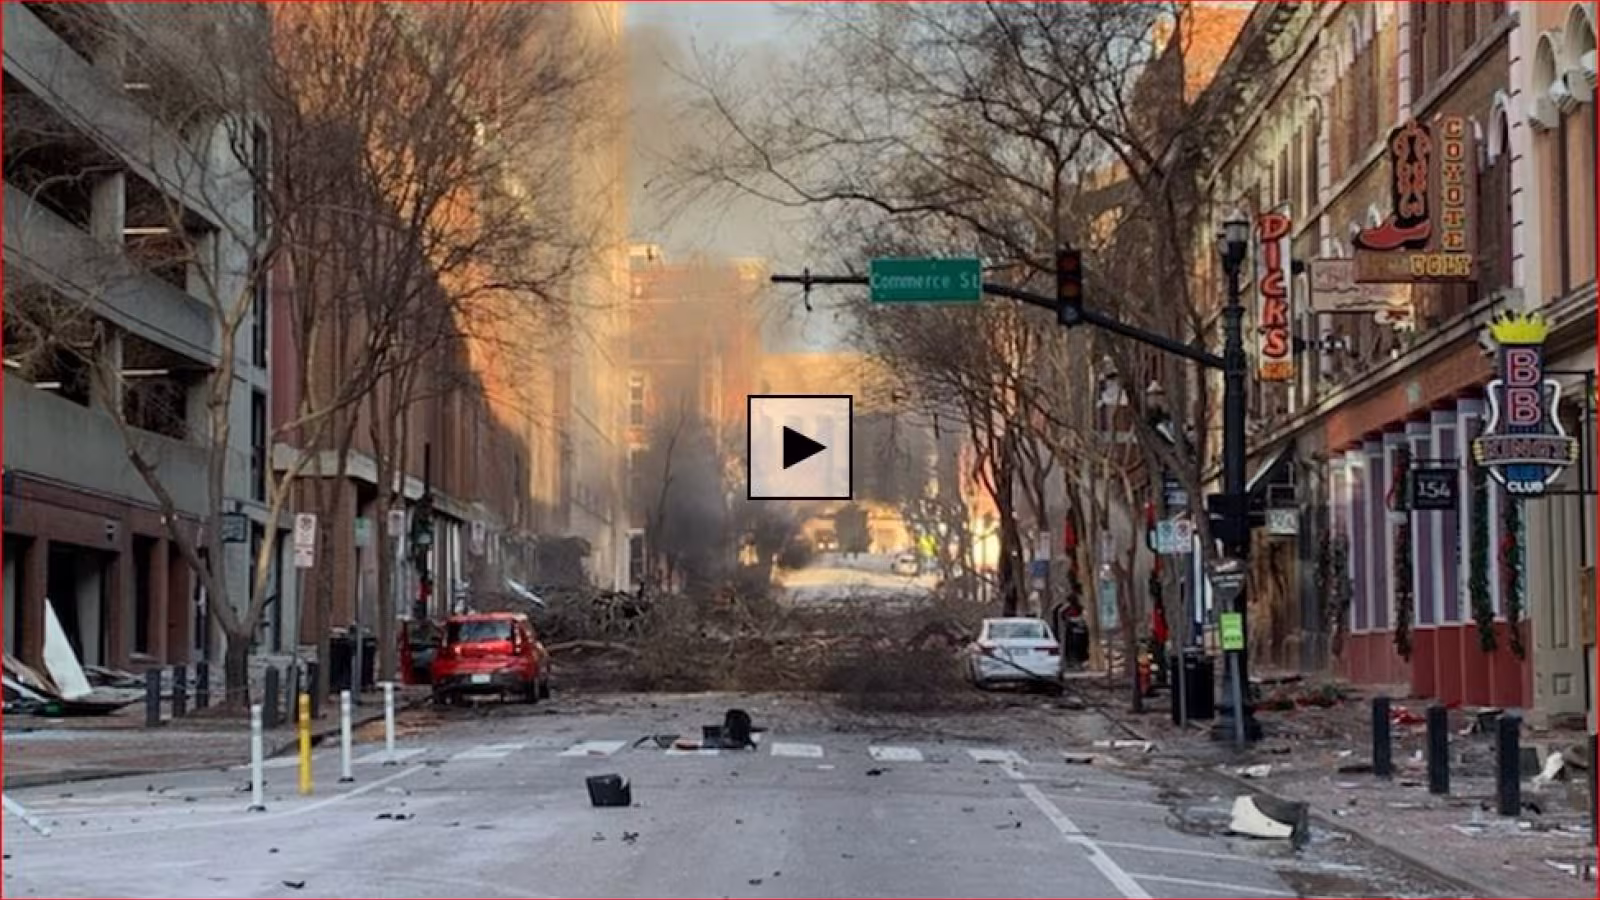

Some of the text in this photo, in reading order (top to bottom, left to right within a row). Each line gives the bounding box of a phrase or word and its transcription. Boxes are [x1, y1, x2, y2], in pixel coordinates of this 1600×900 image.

[1441, 114, 1465, 252] COYOTE
[1409, 253, 1473, 277] UGLY
[871, 272, 980, 290] Commerce St
[1417, 481, 1451, 498] 154
[1507, 480, 1545, 493] CLUB
